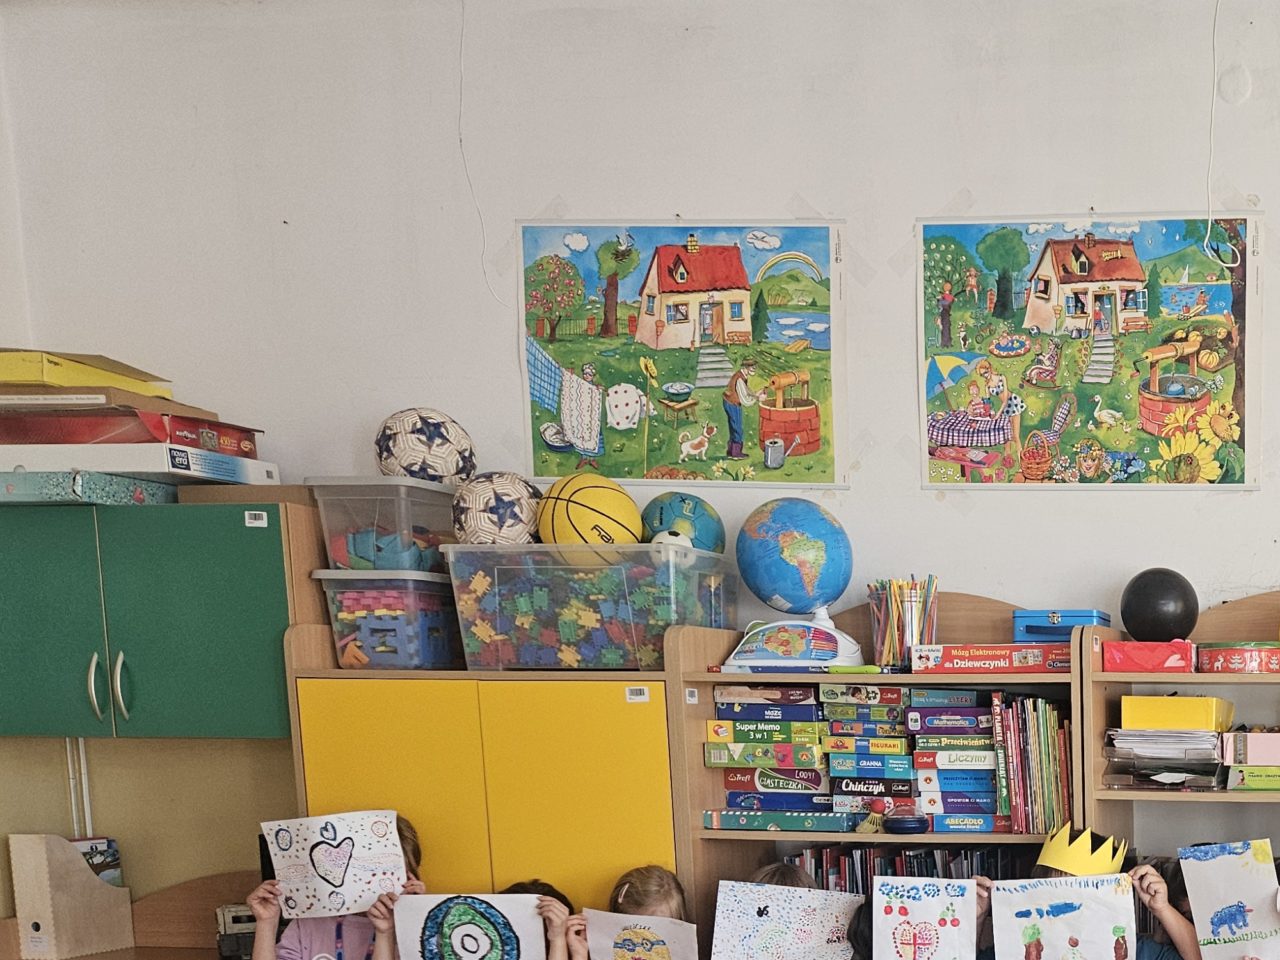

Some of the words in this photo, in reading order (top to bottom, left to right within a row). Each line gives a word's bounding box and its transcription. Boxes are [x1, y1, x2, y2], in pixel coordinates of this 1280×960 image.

[951, 648, 970, 657] Mózg
[970, 648, 1010, 657] Elektronowy
[953, 658, 1009, 669] Dziewczynki
[735, 722, 757, 732] Super
[757, 722, 781, 731] Memo
[749, 731, 754, 739] 3
[763, 731, 768, 739] 1
[947, 753, 987, 765] Liczymy
[841, 778, 885, 795] Chińczyk
